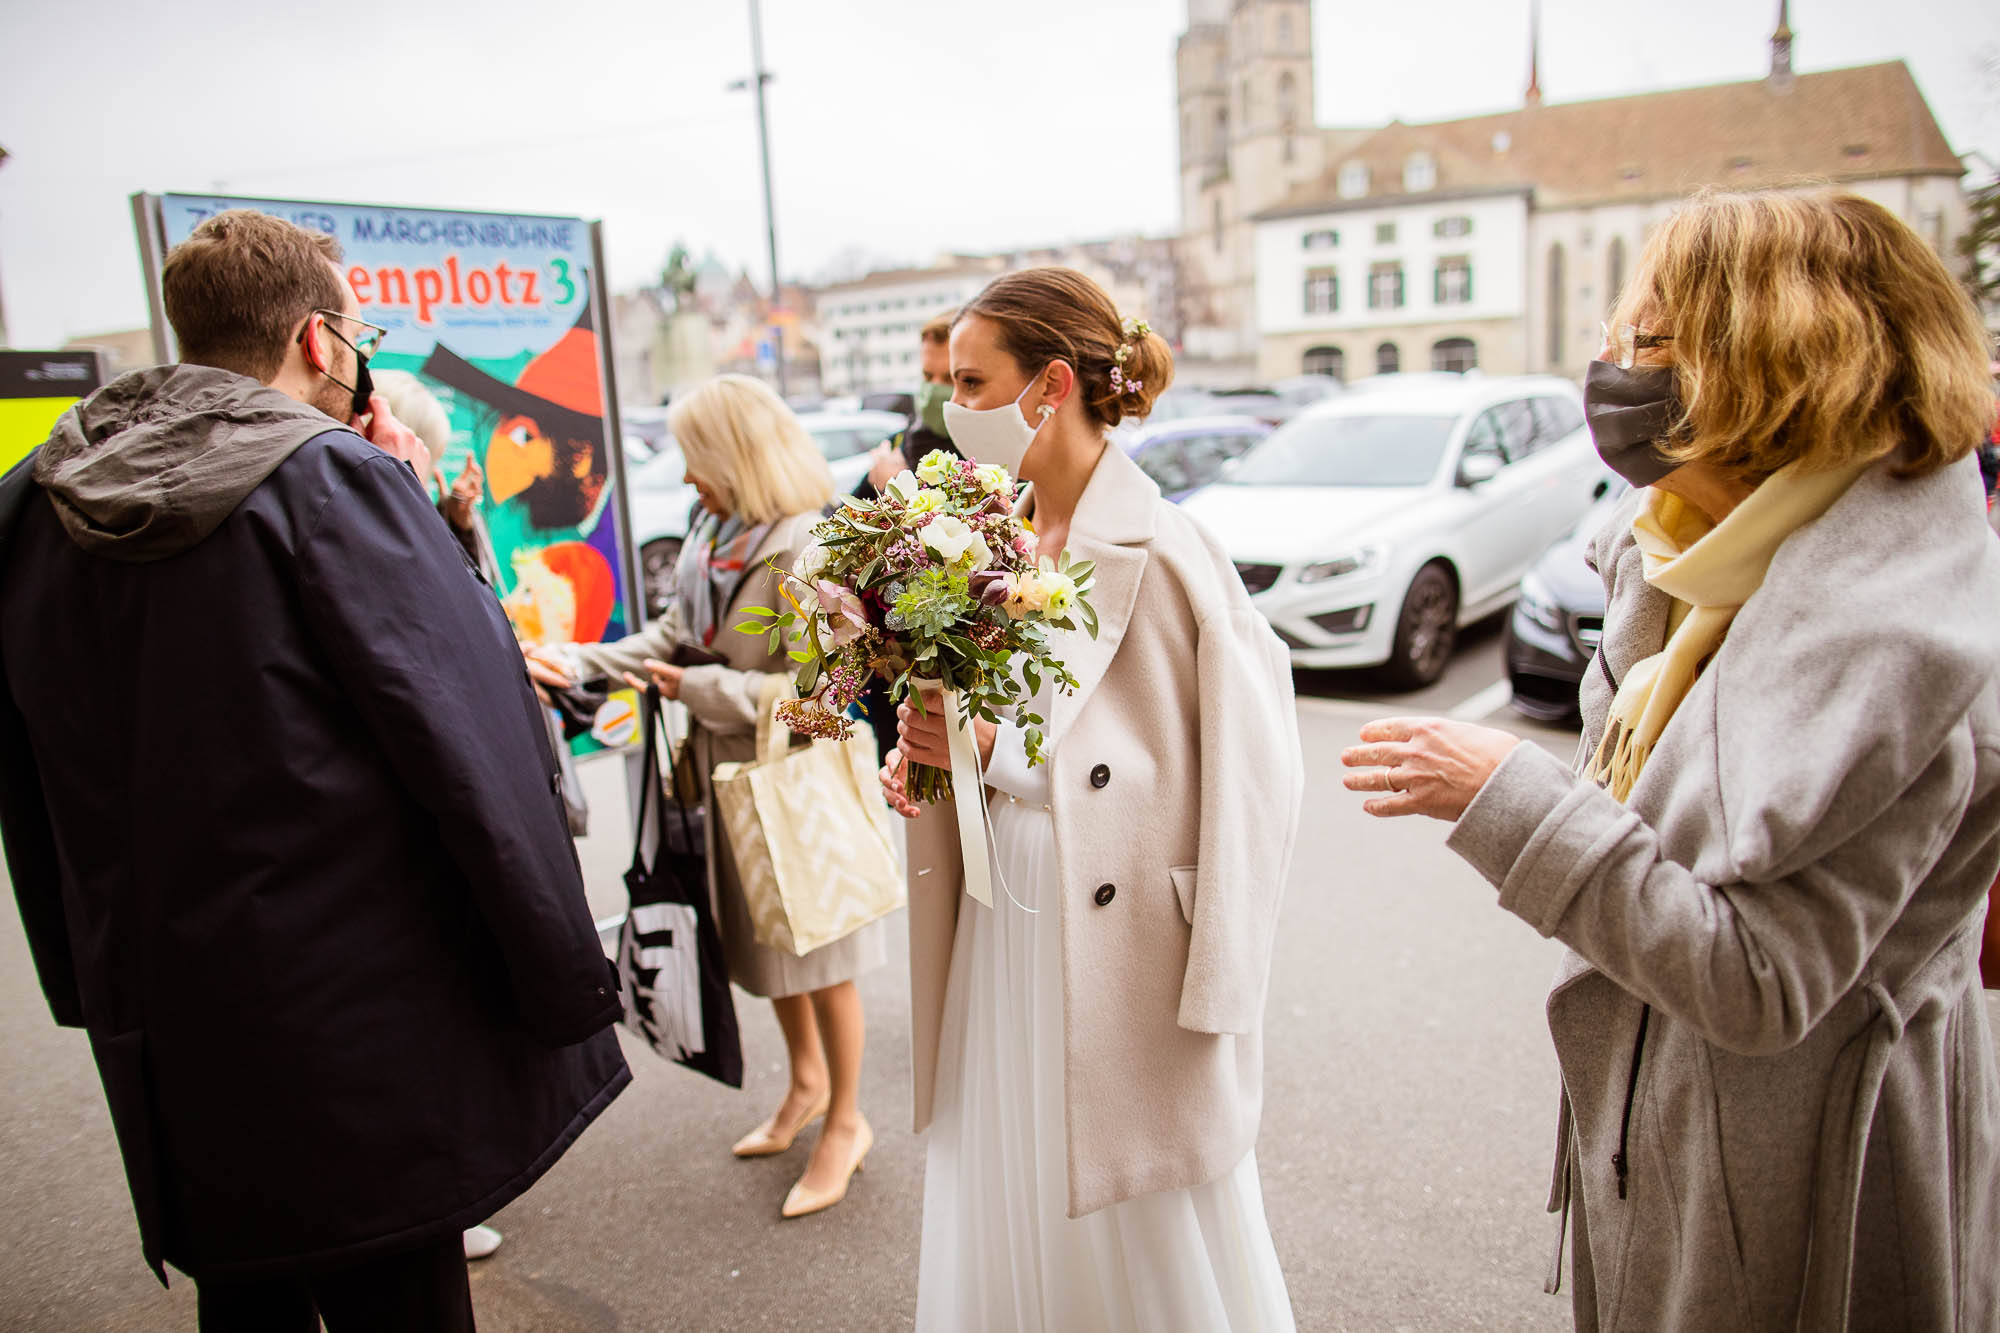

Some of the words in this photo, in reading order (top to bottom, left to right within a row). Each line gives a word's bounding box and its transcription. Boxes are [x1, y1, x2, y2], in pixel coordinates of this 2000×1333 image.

[354, 212, 574, 250] MÄRCHENBÜHNE
[347, 256, 541, 322] enplotz
[551, 258, 575, 305] 3
